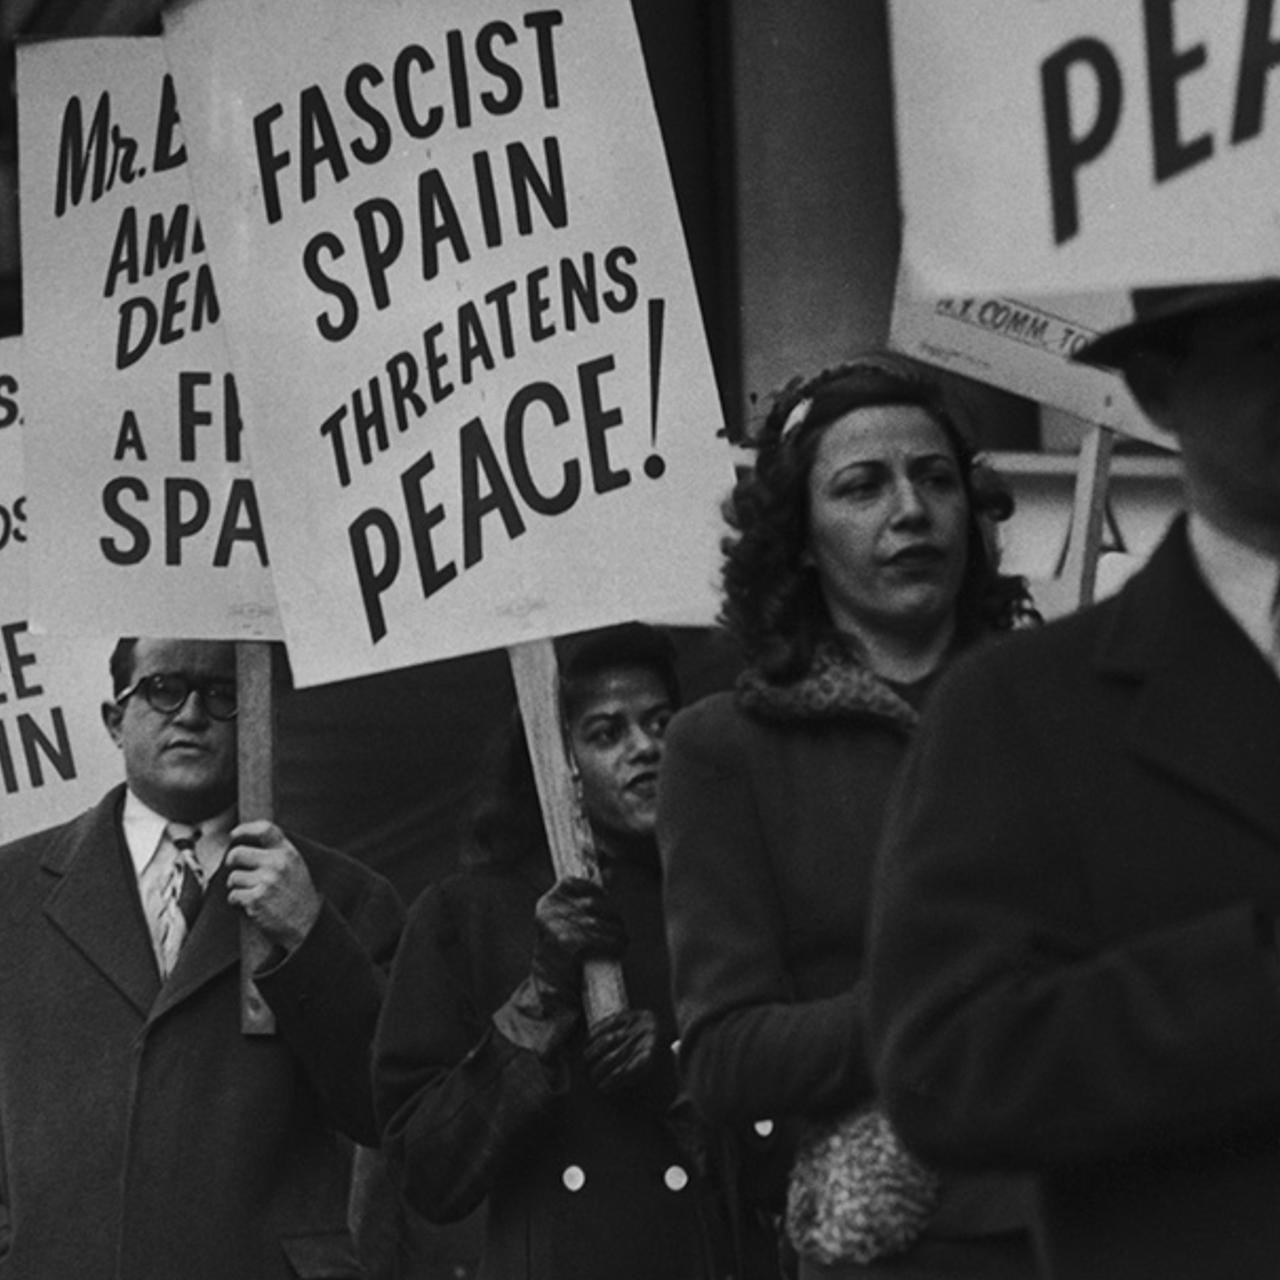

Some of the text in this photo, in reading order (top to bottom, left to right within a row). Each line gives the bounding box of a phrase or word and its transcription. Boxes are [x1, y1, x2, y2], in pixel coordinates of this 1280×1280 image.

[53, 88, 147, 219] Mr.
[251, 7, 565, 225] FASCIST
[301, 134, 570, 344] SPAIN
[113, 408, 148, 462] A
[318, 244, 640, 489] THREATENS
[347, 296, 667, 646] PEACE!
[98, 474, 270, 569] SPA
